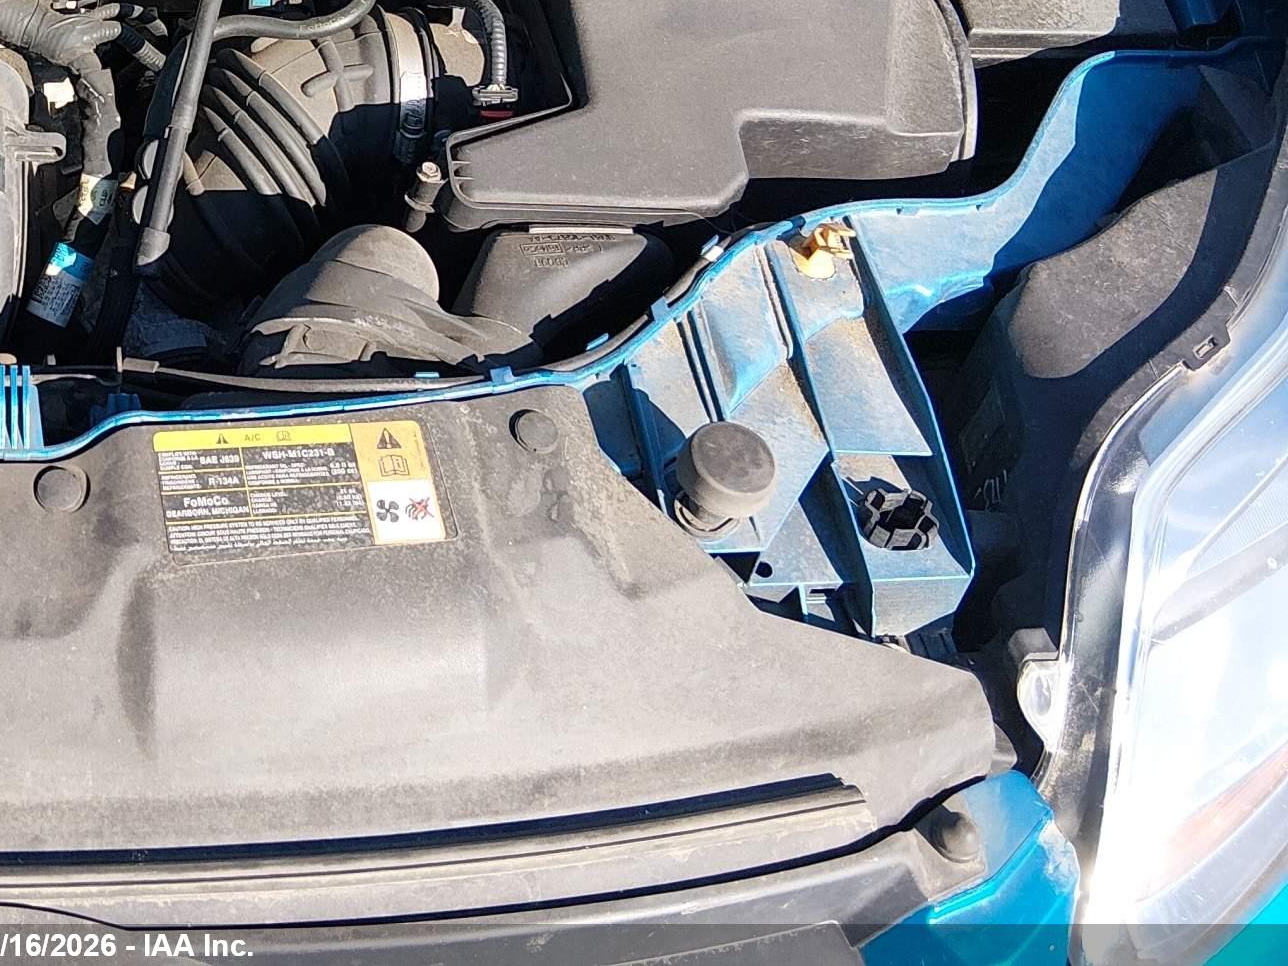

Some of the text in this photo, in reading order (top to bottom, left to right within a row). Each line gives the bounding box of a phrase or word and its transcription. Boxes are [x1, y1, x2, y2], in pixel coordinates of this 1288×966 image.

[244, 434, 262, 442] A/C
[199, 456, 219, 465] SAE
[208, 477, 240, 486] R-134A
[182, 496, 229, 508] FoMoCo
[211, 506, 250, 516] MICHIGAN
